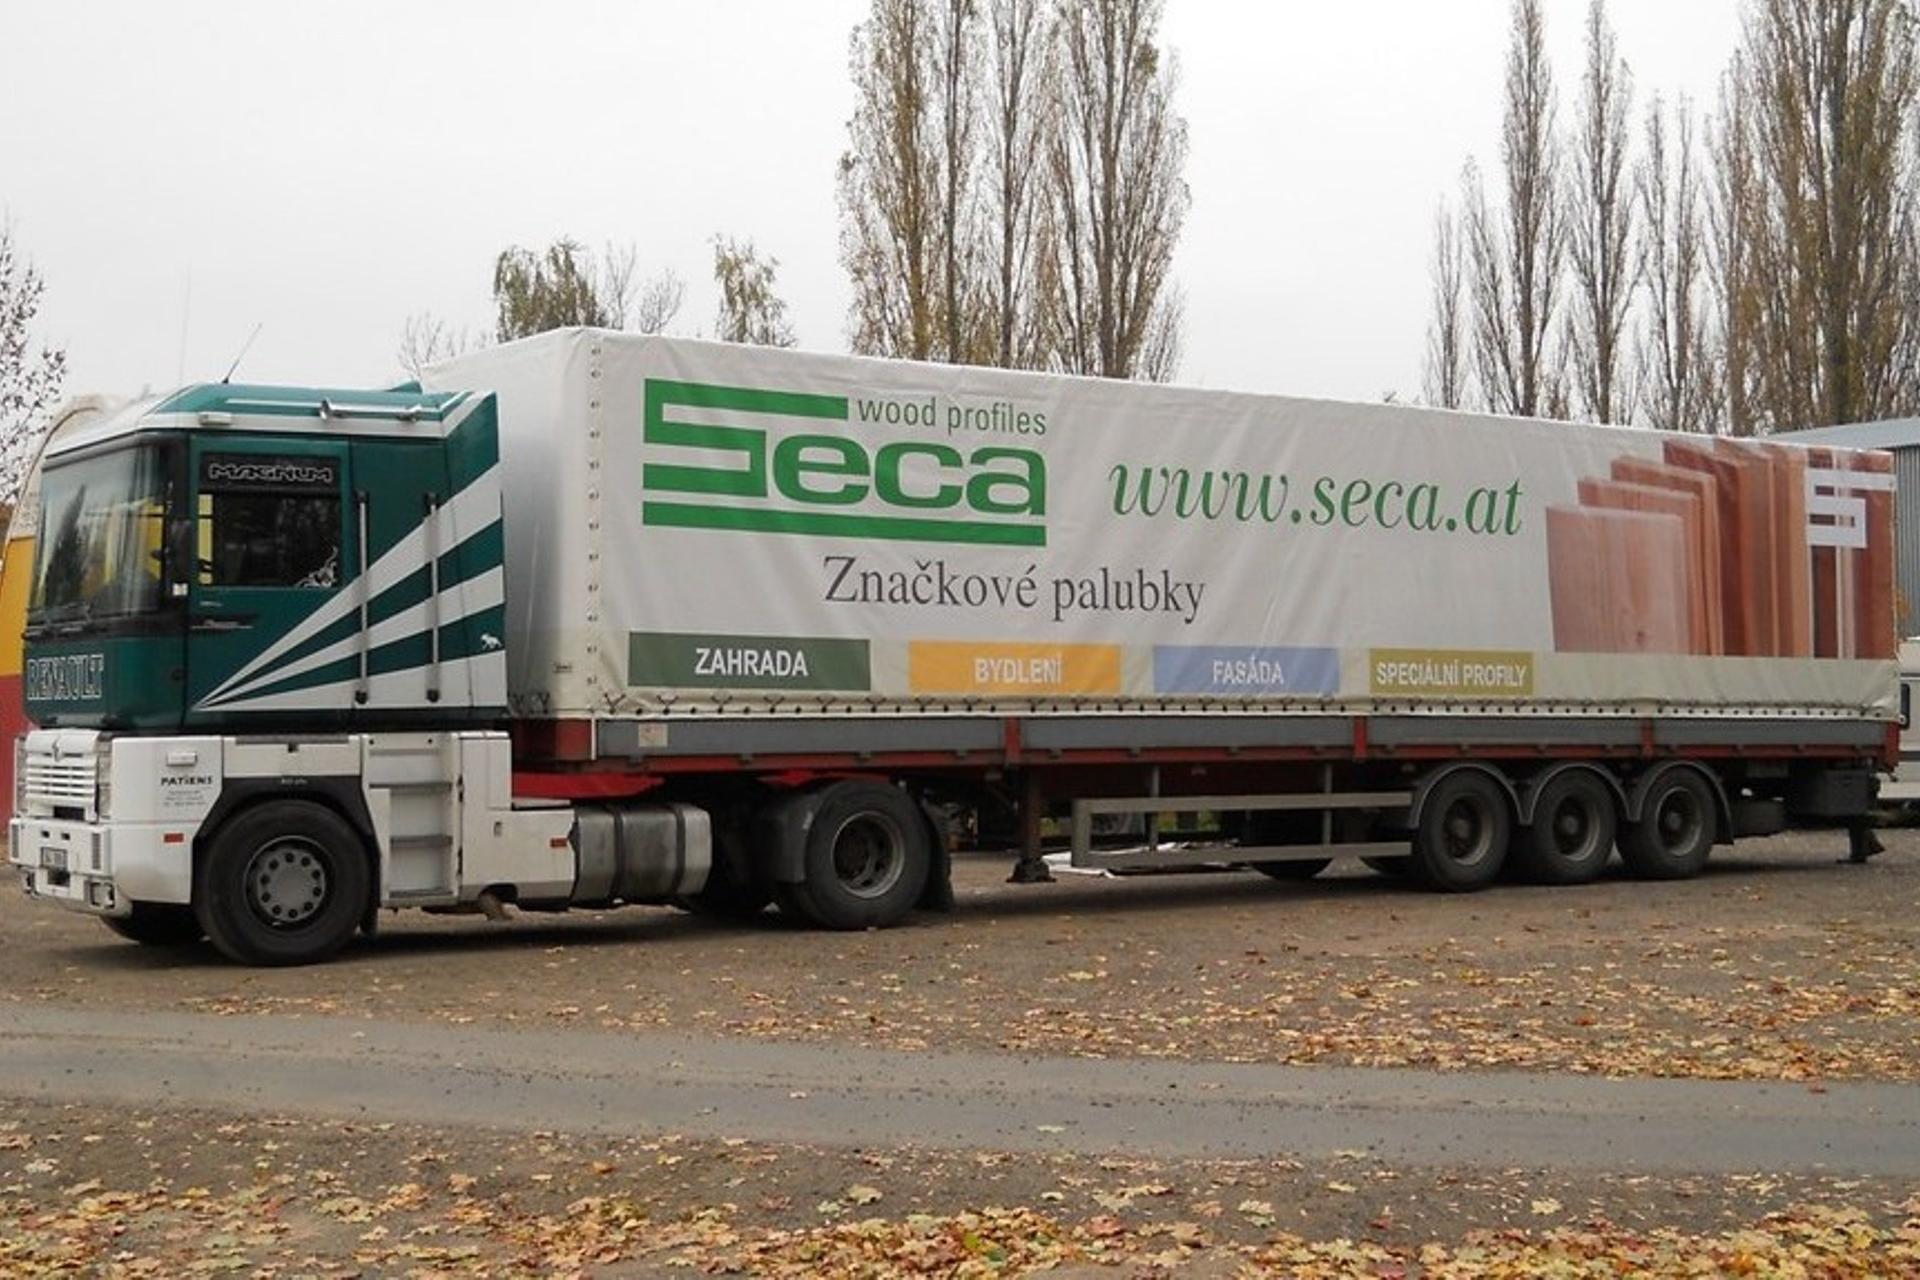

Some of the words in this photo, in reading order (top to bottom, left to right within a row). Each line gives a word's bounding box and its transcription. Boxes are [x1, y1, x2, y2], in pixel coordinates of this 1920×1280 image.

[858, 396, 937, 428] wood
[948, 402, 1047, 437] profiles
[643, 378, 1047, 517] Seca
[1108, 462, 1523, 536] www.seca.at
[823, 555, 1037, 608] Značkové
[1051, 567, 1206, 624] palubky
[27, 654, 104, 700] RENAULT
[694, 648, 808, 677] ZAHRADA
[974, 655, 1063, 686] BYDLENÍ
[1213, 655, 1285, 685] FASÁDA
[1376, 658, 1459, 685] SPECIÁLNÍ
[1463, 664, 1527, 687] PROFILY
